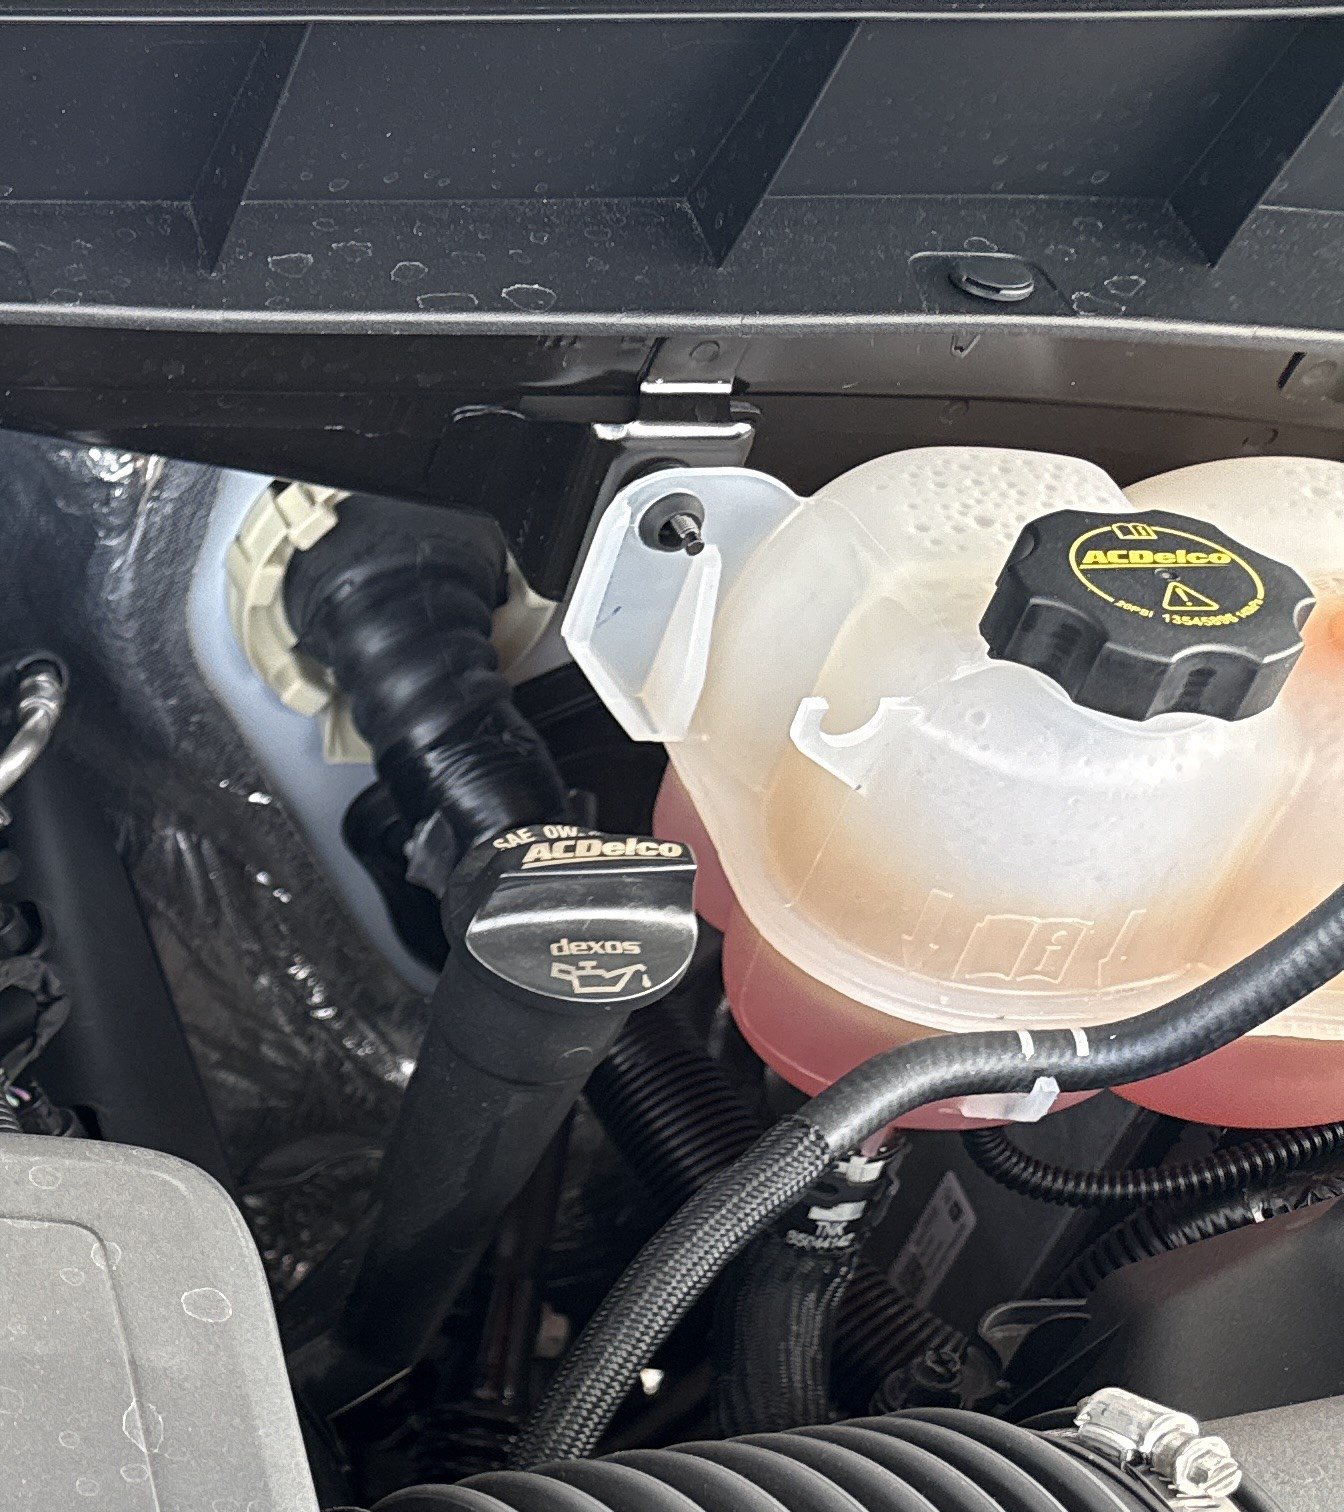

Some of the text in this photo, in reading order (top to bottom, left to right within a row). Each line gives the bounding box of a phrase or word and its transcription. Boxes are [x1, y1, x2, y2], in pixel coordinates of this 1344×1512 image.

[1082, 549, 1232, 565] ACDelco
[493, 828, 537, 850] SAE
[522, 838, 682, 862] ACDelco
[550, 938, 641, 955] dexos
